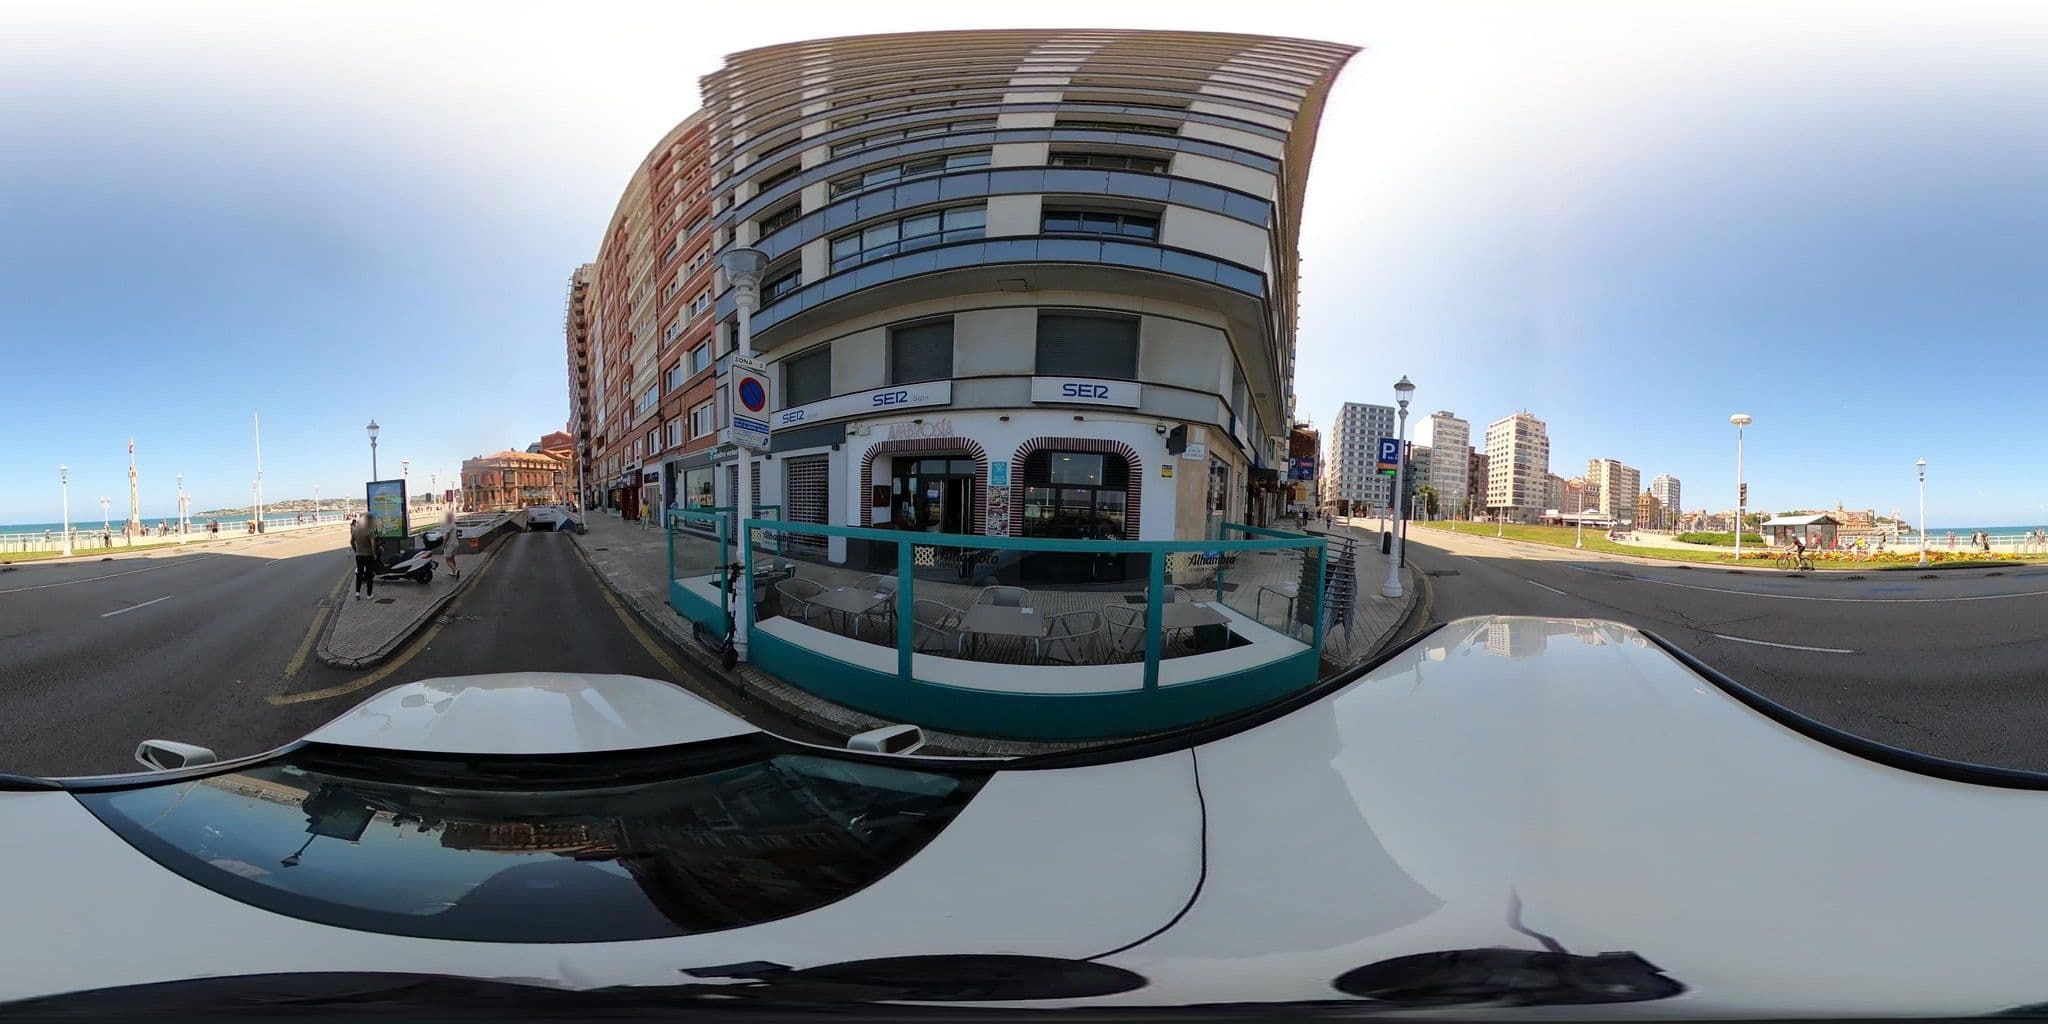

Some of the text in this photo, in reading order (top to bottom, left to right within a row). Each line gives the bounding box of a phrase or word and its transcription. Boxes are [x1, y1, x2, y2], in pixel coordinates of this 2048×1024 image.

[735, 357, 752, 365] ZONA
[873, 391, 908, 406] SER
[1062, 384, 1108, 399] SER
[783, 411, 804, 424] SER
[1382, 443, 1395, 460] P
[1290, 458, 1296, 469] P
[1186, 553, 1236, 567] Alhambra
